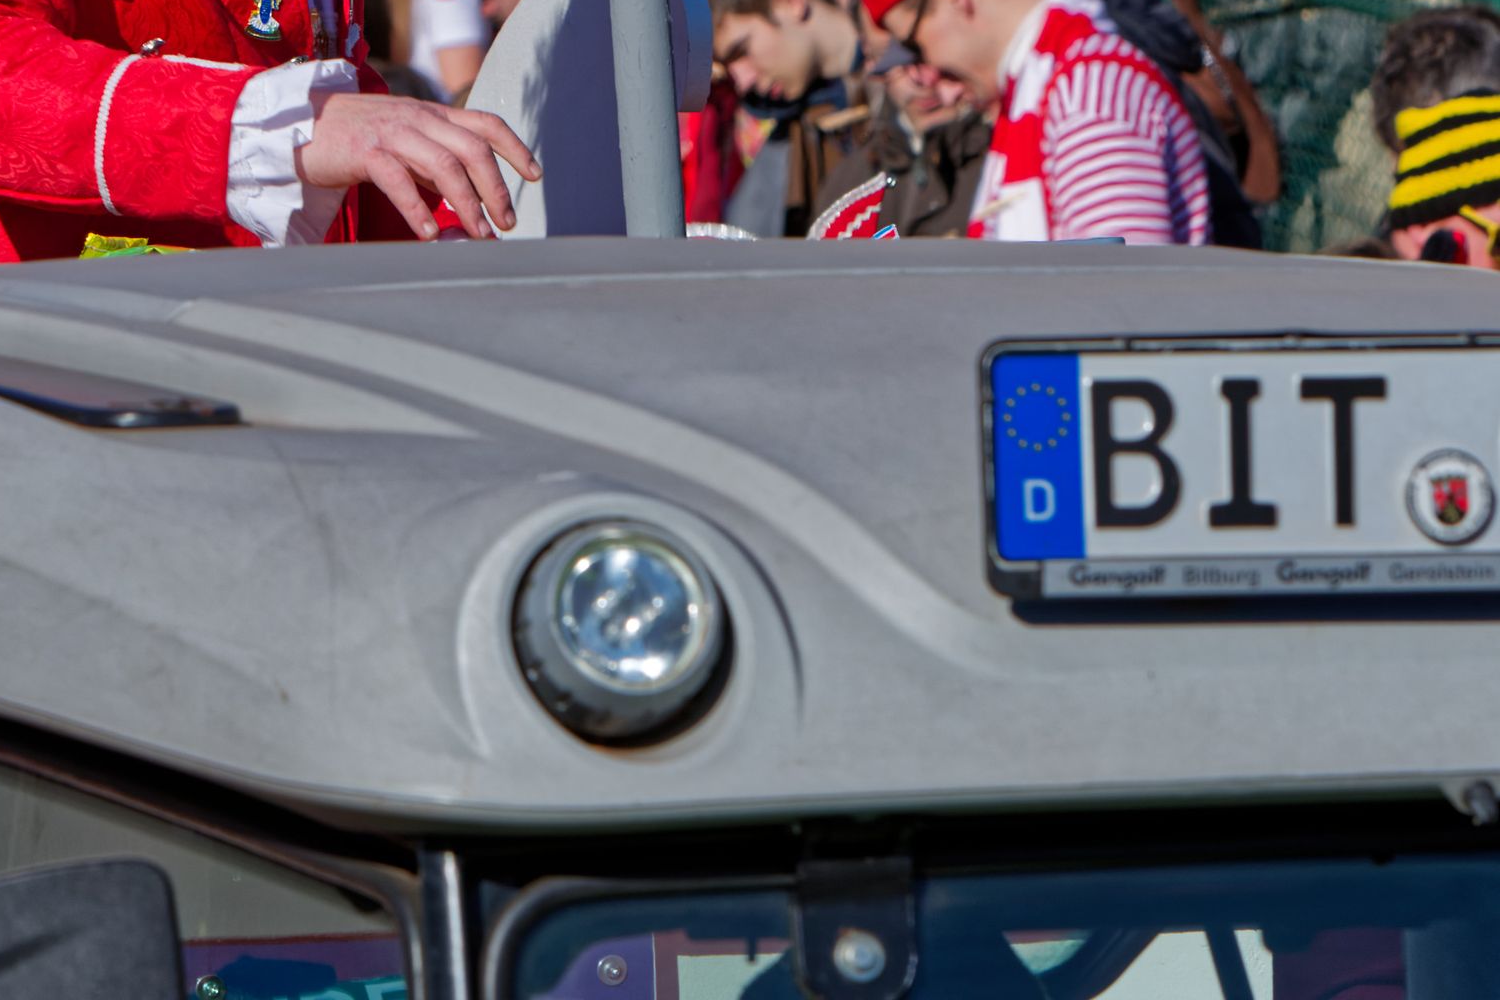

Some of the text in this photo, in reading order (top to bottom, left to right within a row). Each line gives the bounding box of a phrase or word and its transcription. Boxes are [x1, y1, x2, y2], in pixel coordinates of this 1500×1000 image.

[1091, 375, 1388, 528] BIT
[1023, 479, 1055, 522] D
[1182, 565, 1261, 588] Bitburg
